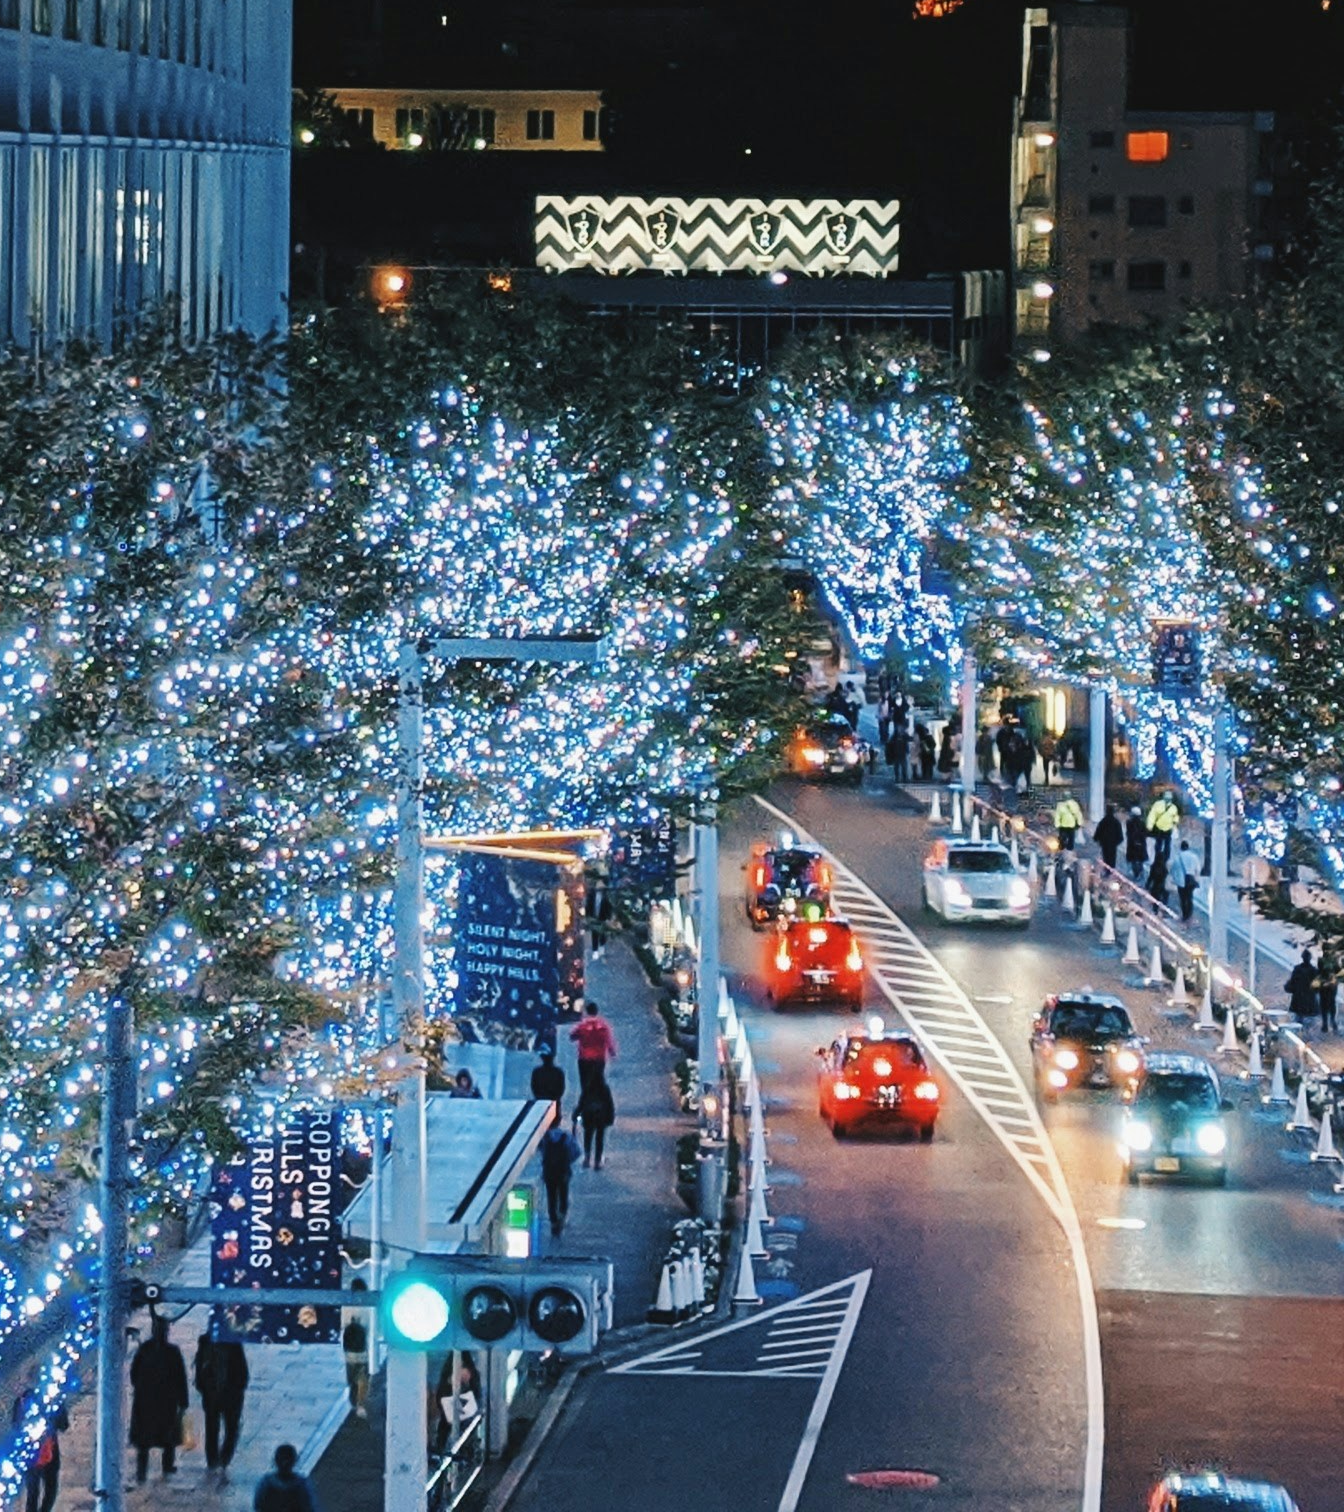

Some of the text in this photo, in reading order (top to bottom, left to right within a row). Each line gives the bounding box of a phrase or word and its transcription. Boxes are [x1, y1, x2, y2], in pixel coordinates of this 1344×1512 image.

[466, 960, 505, 976] HAPPY
[467, 942, 498, 957] HOLY
[250, 1126, 274, 1268] RISTMAS
[308, 1110, 332, 1242] ROPPONGI
